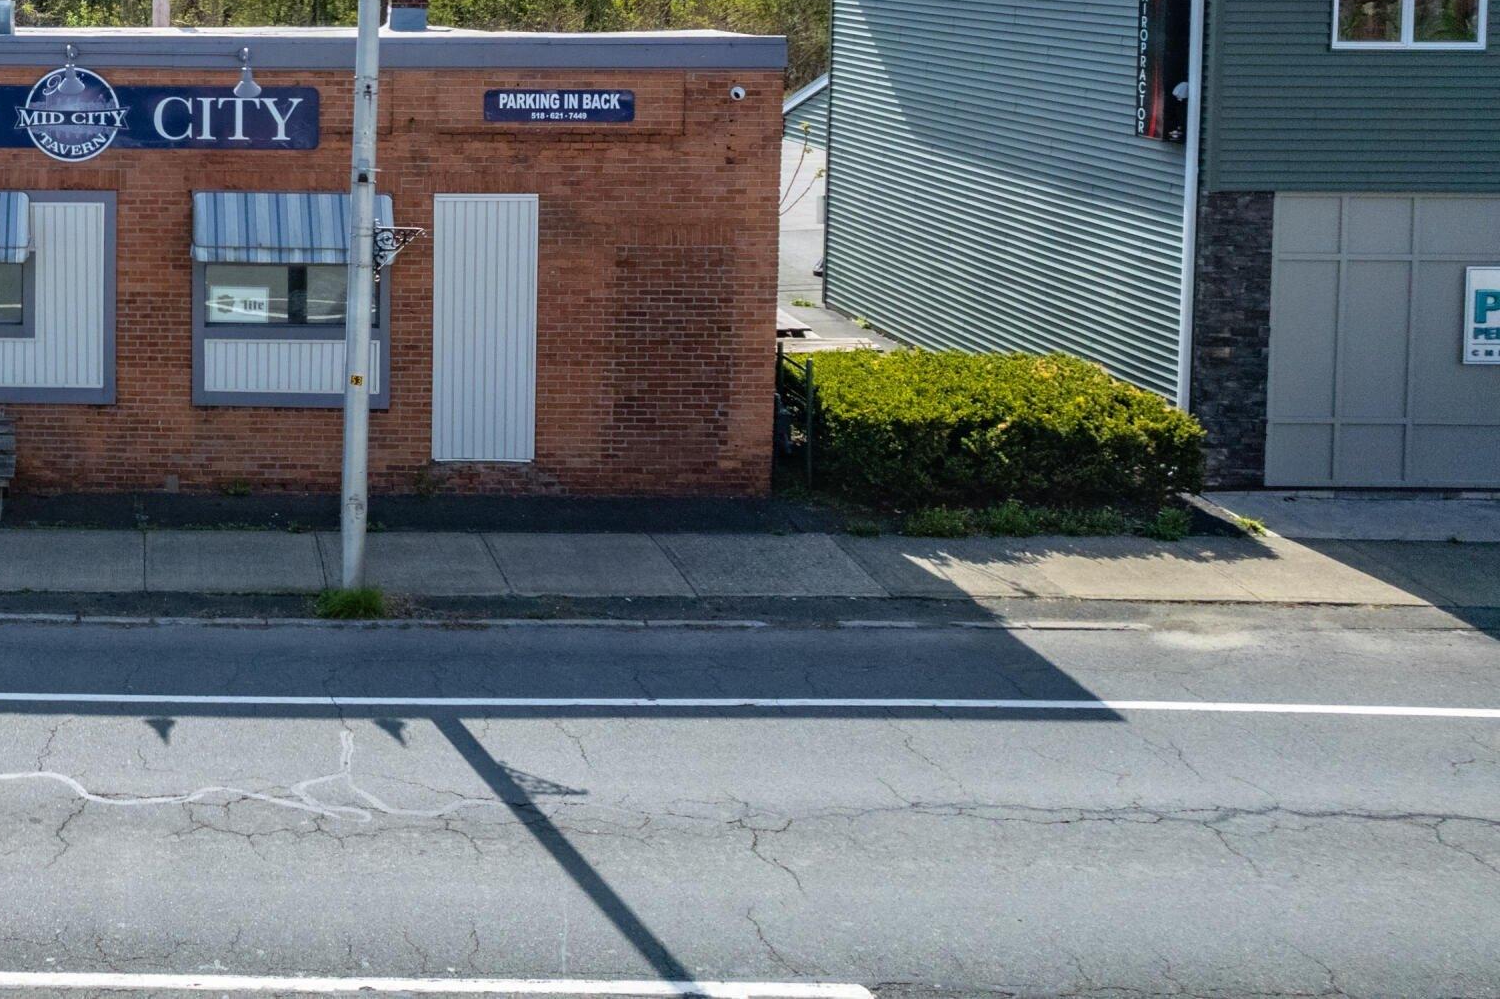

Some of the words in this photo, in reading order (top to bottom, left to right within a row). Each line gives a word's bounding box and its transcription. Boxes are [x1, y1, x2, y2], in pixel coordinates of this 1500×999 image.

[499, 93, 560, 109] PARKING
[564, 94, 579, 109] IN
[582, 94, 621, 110] BACK
[19, 109, 65, 127] MID
[71, 109, 126, 127] CITY
[152, 96, 304, 141] CITY
[40, 132, 107, 156] TAVERN
